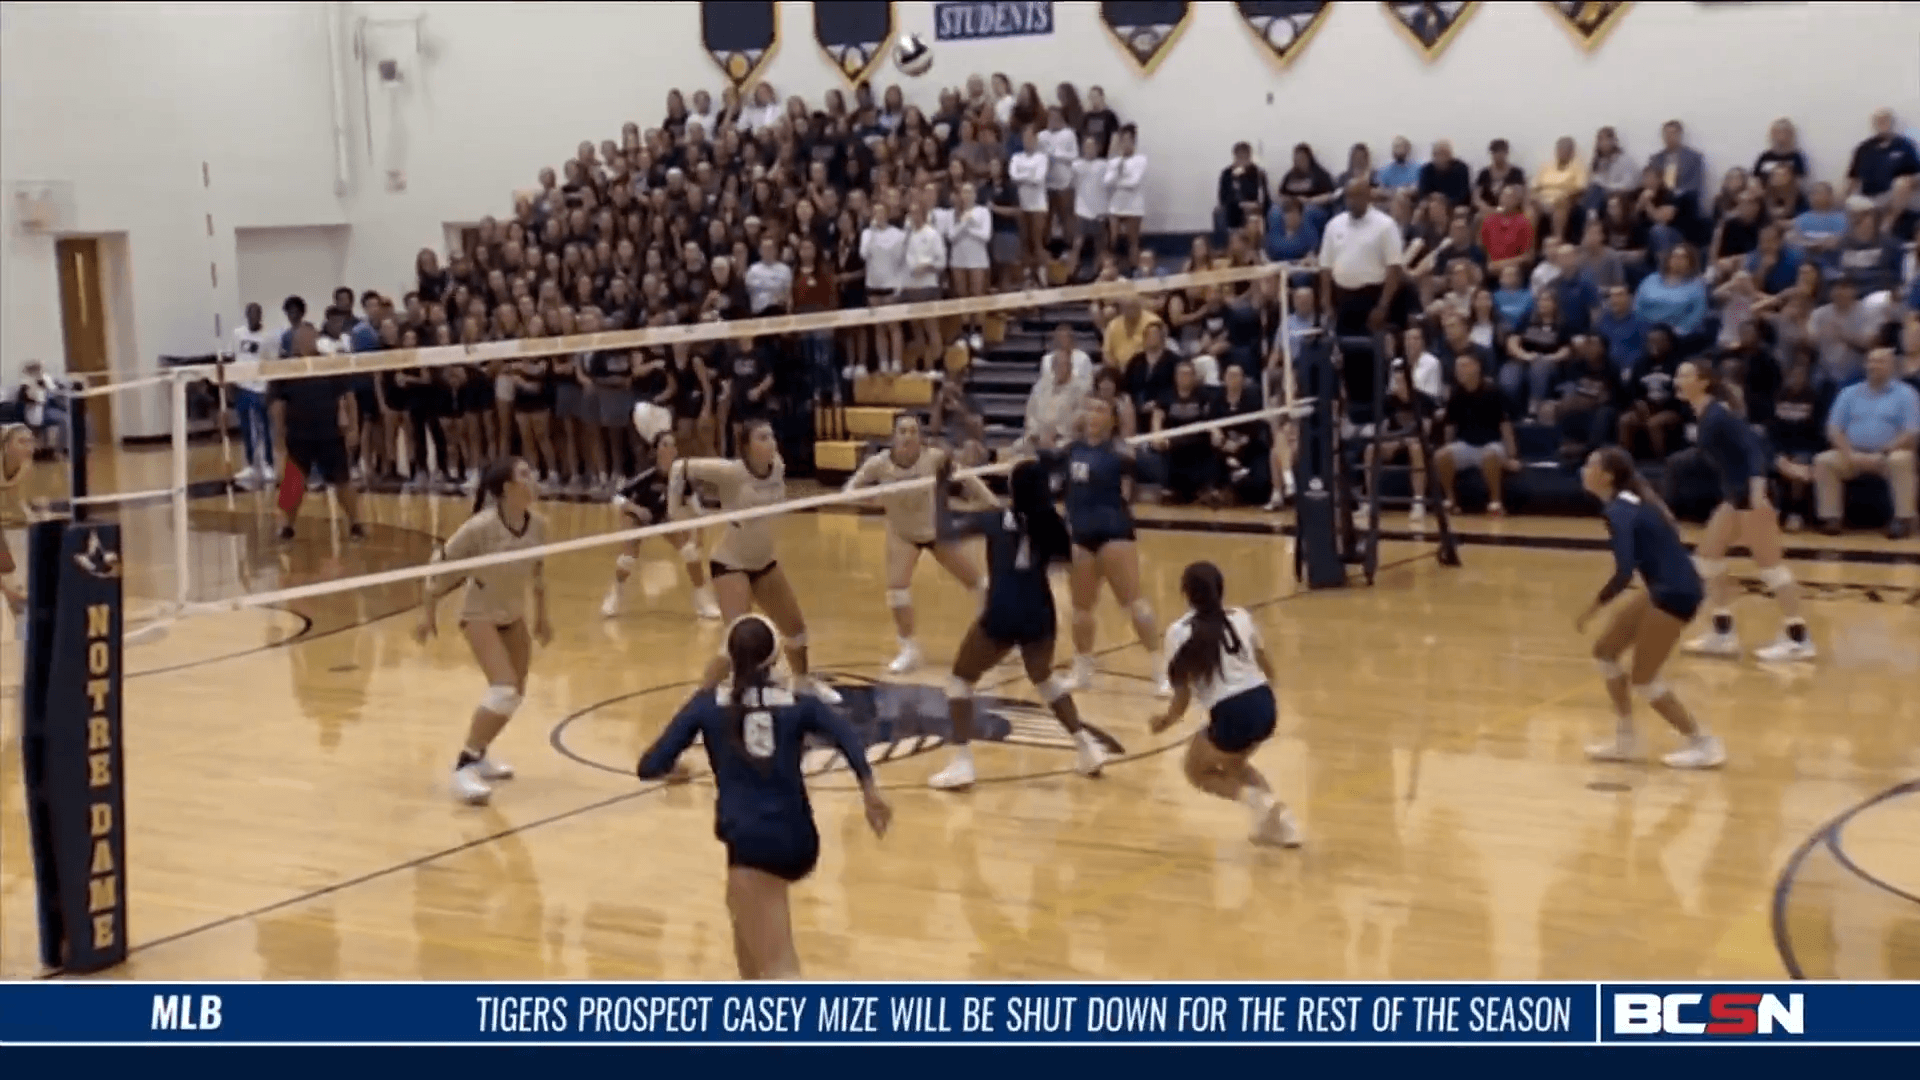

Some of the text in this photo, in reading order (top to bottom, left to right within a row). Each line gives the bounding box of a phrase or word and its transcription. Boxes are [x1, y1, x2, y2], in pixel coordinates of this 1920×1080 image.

[939, 2, 1049, 36] STUDENTS
[87, 604, 116, 949] NOTRE DAME
